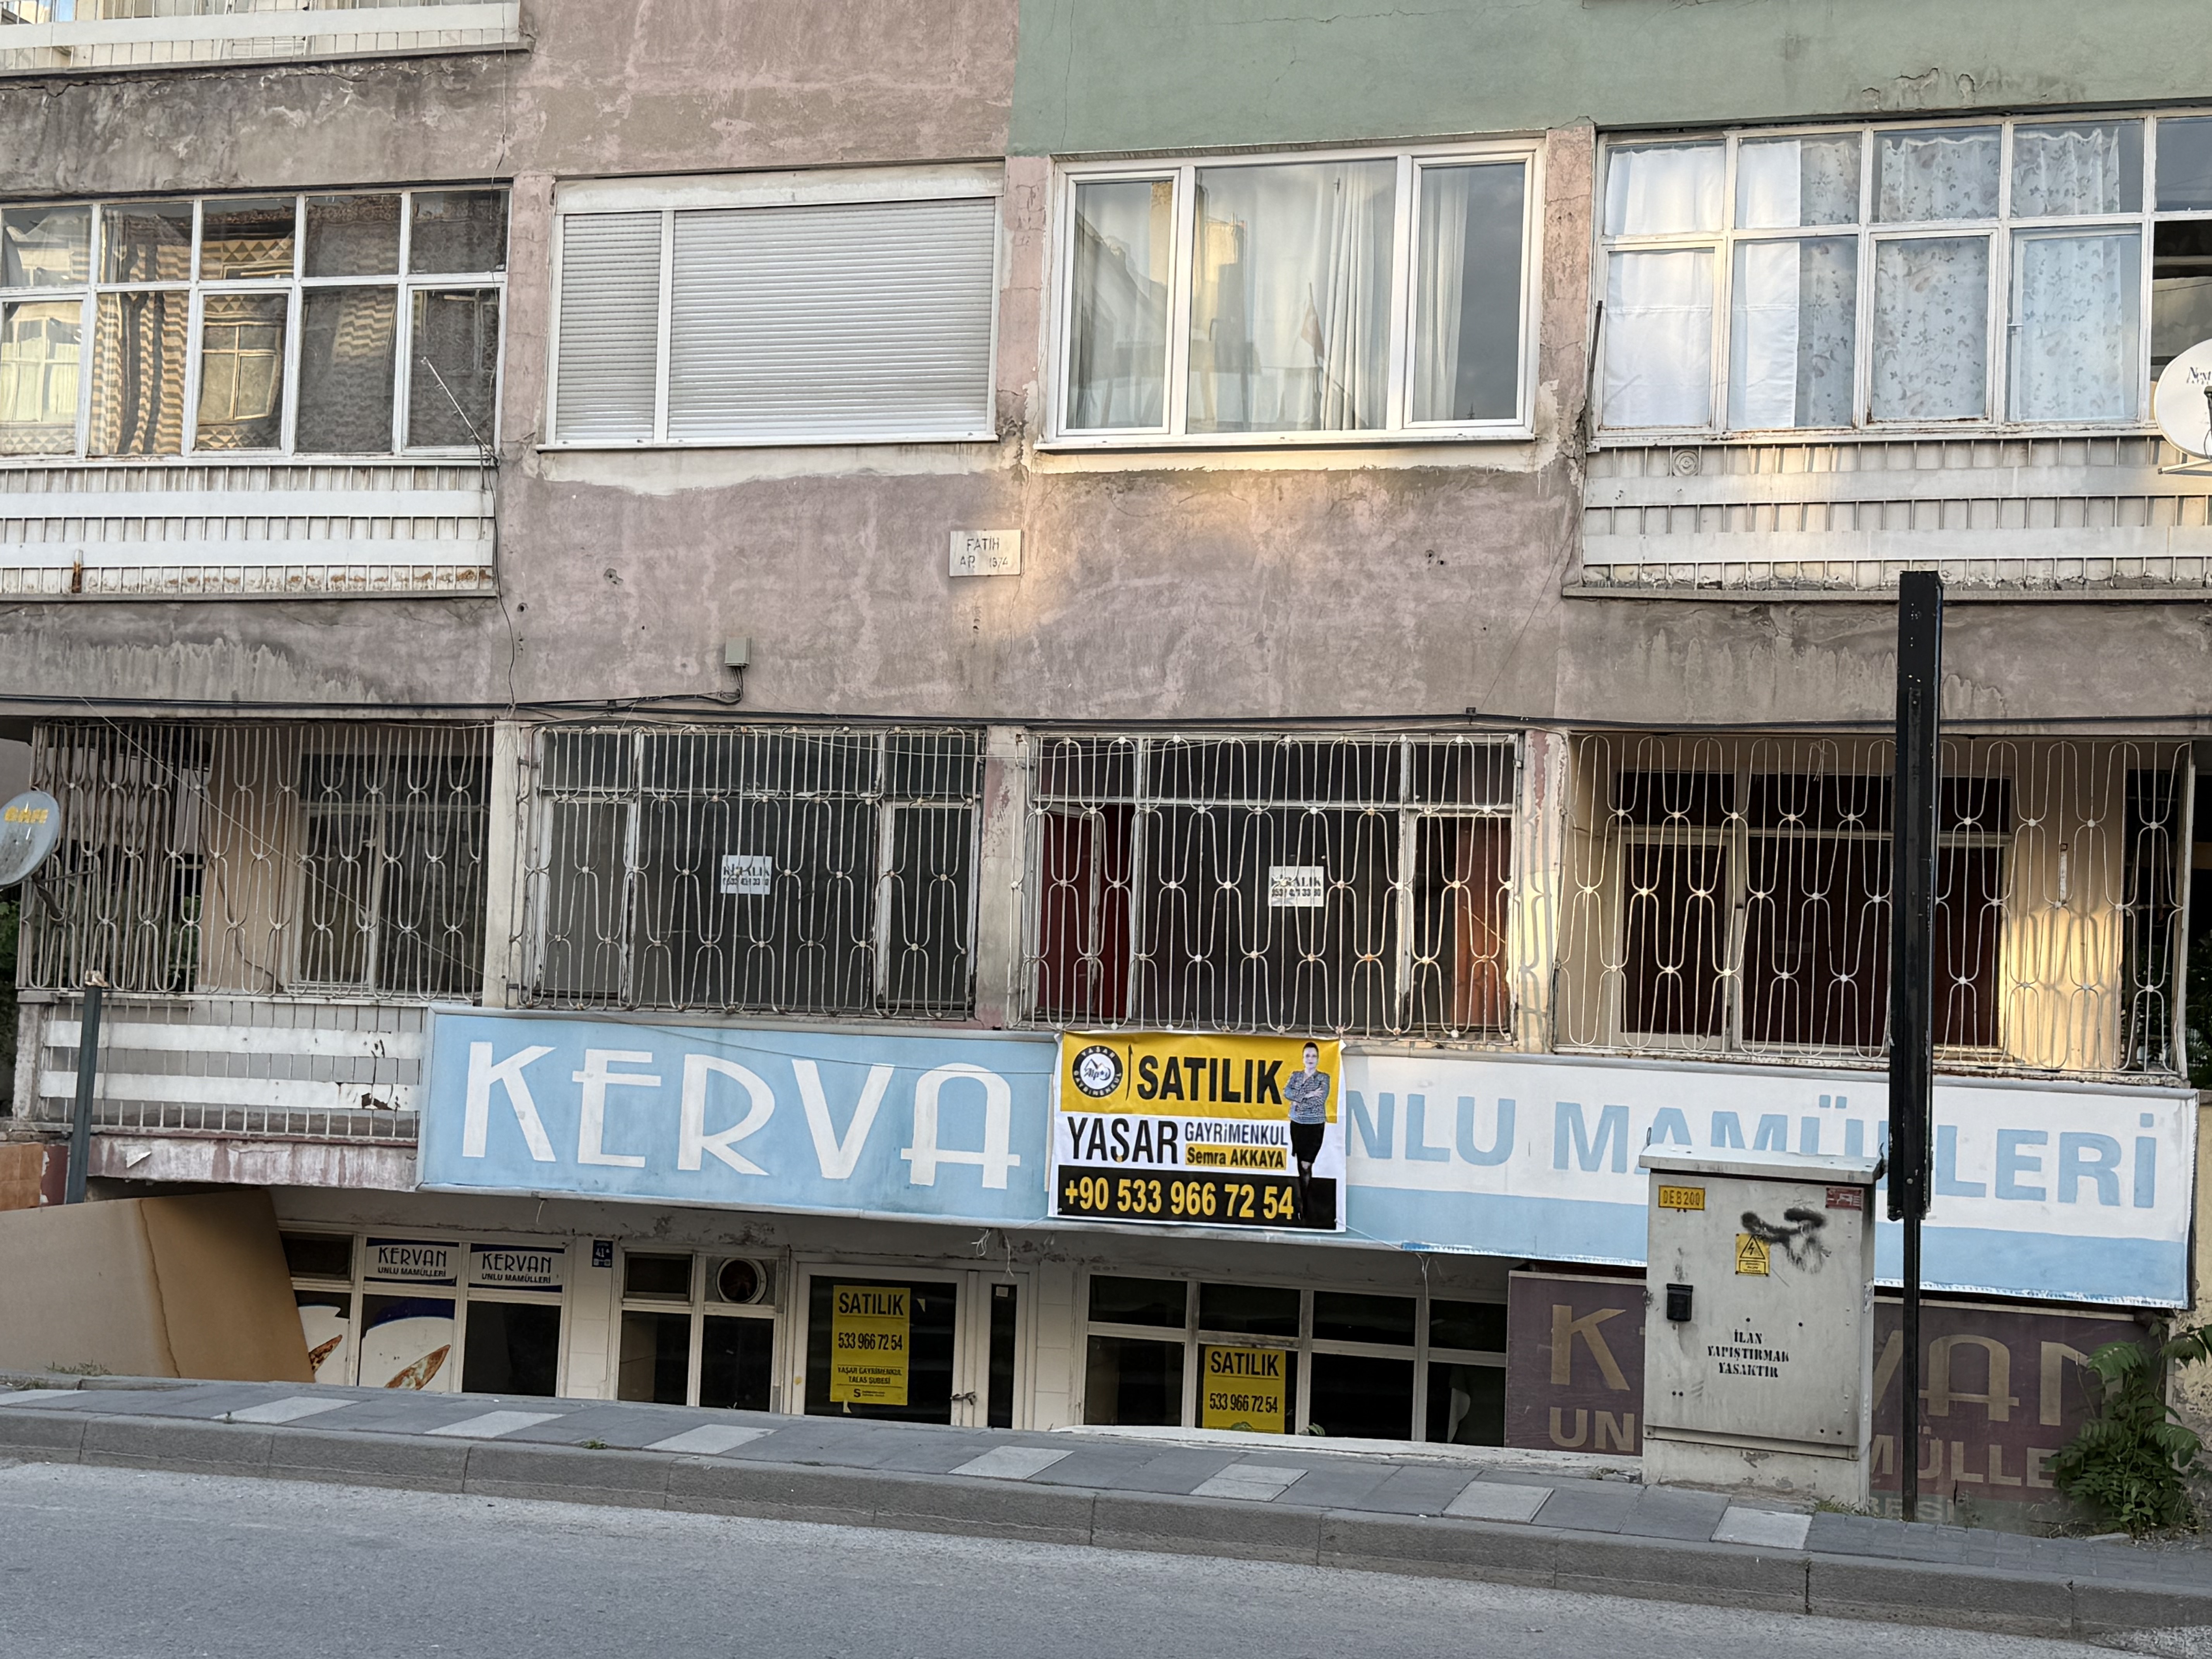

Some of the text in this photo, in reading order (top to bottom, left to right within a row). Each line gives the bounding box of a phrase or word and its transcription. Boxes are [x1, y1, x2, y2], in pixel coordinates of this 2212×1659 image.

[1137, 1055, 1283, 1104] SATILIK
[462, 1041, 1054, 1192] KERVA
[1187, 1147, 1284, 1168] Semra AKKAYA
[1346, 1090, 2157, 1208] NLU MAMÜLERİ
[1065, 1176, 1294, 1220] +90 533 966 72 54
[378, 1247, 447, 1267] KERVAN
[483, 1253, 551, 1273] KERVAN
[378, 1266, 399, 1274] UNLU
[838, 1292, 904, 1316] SATILIK
[838, 1332, 903, 1350] 533 966 72 54
[1734, 1329, 1762, 1344] İLAN
[1211, 1351, 1279, 1376] SATILIK
[1707, 1346, 1789, 1362] YAPIŞTIRMAK
[1719, 1362, 1778, 1378] YASAKTIR
[1210, 1393, 1278, 1413] 533 966 72 54
[1550, 1406, 1635, 1452] UN
